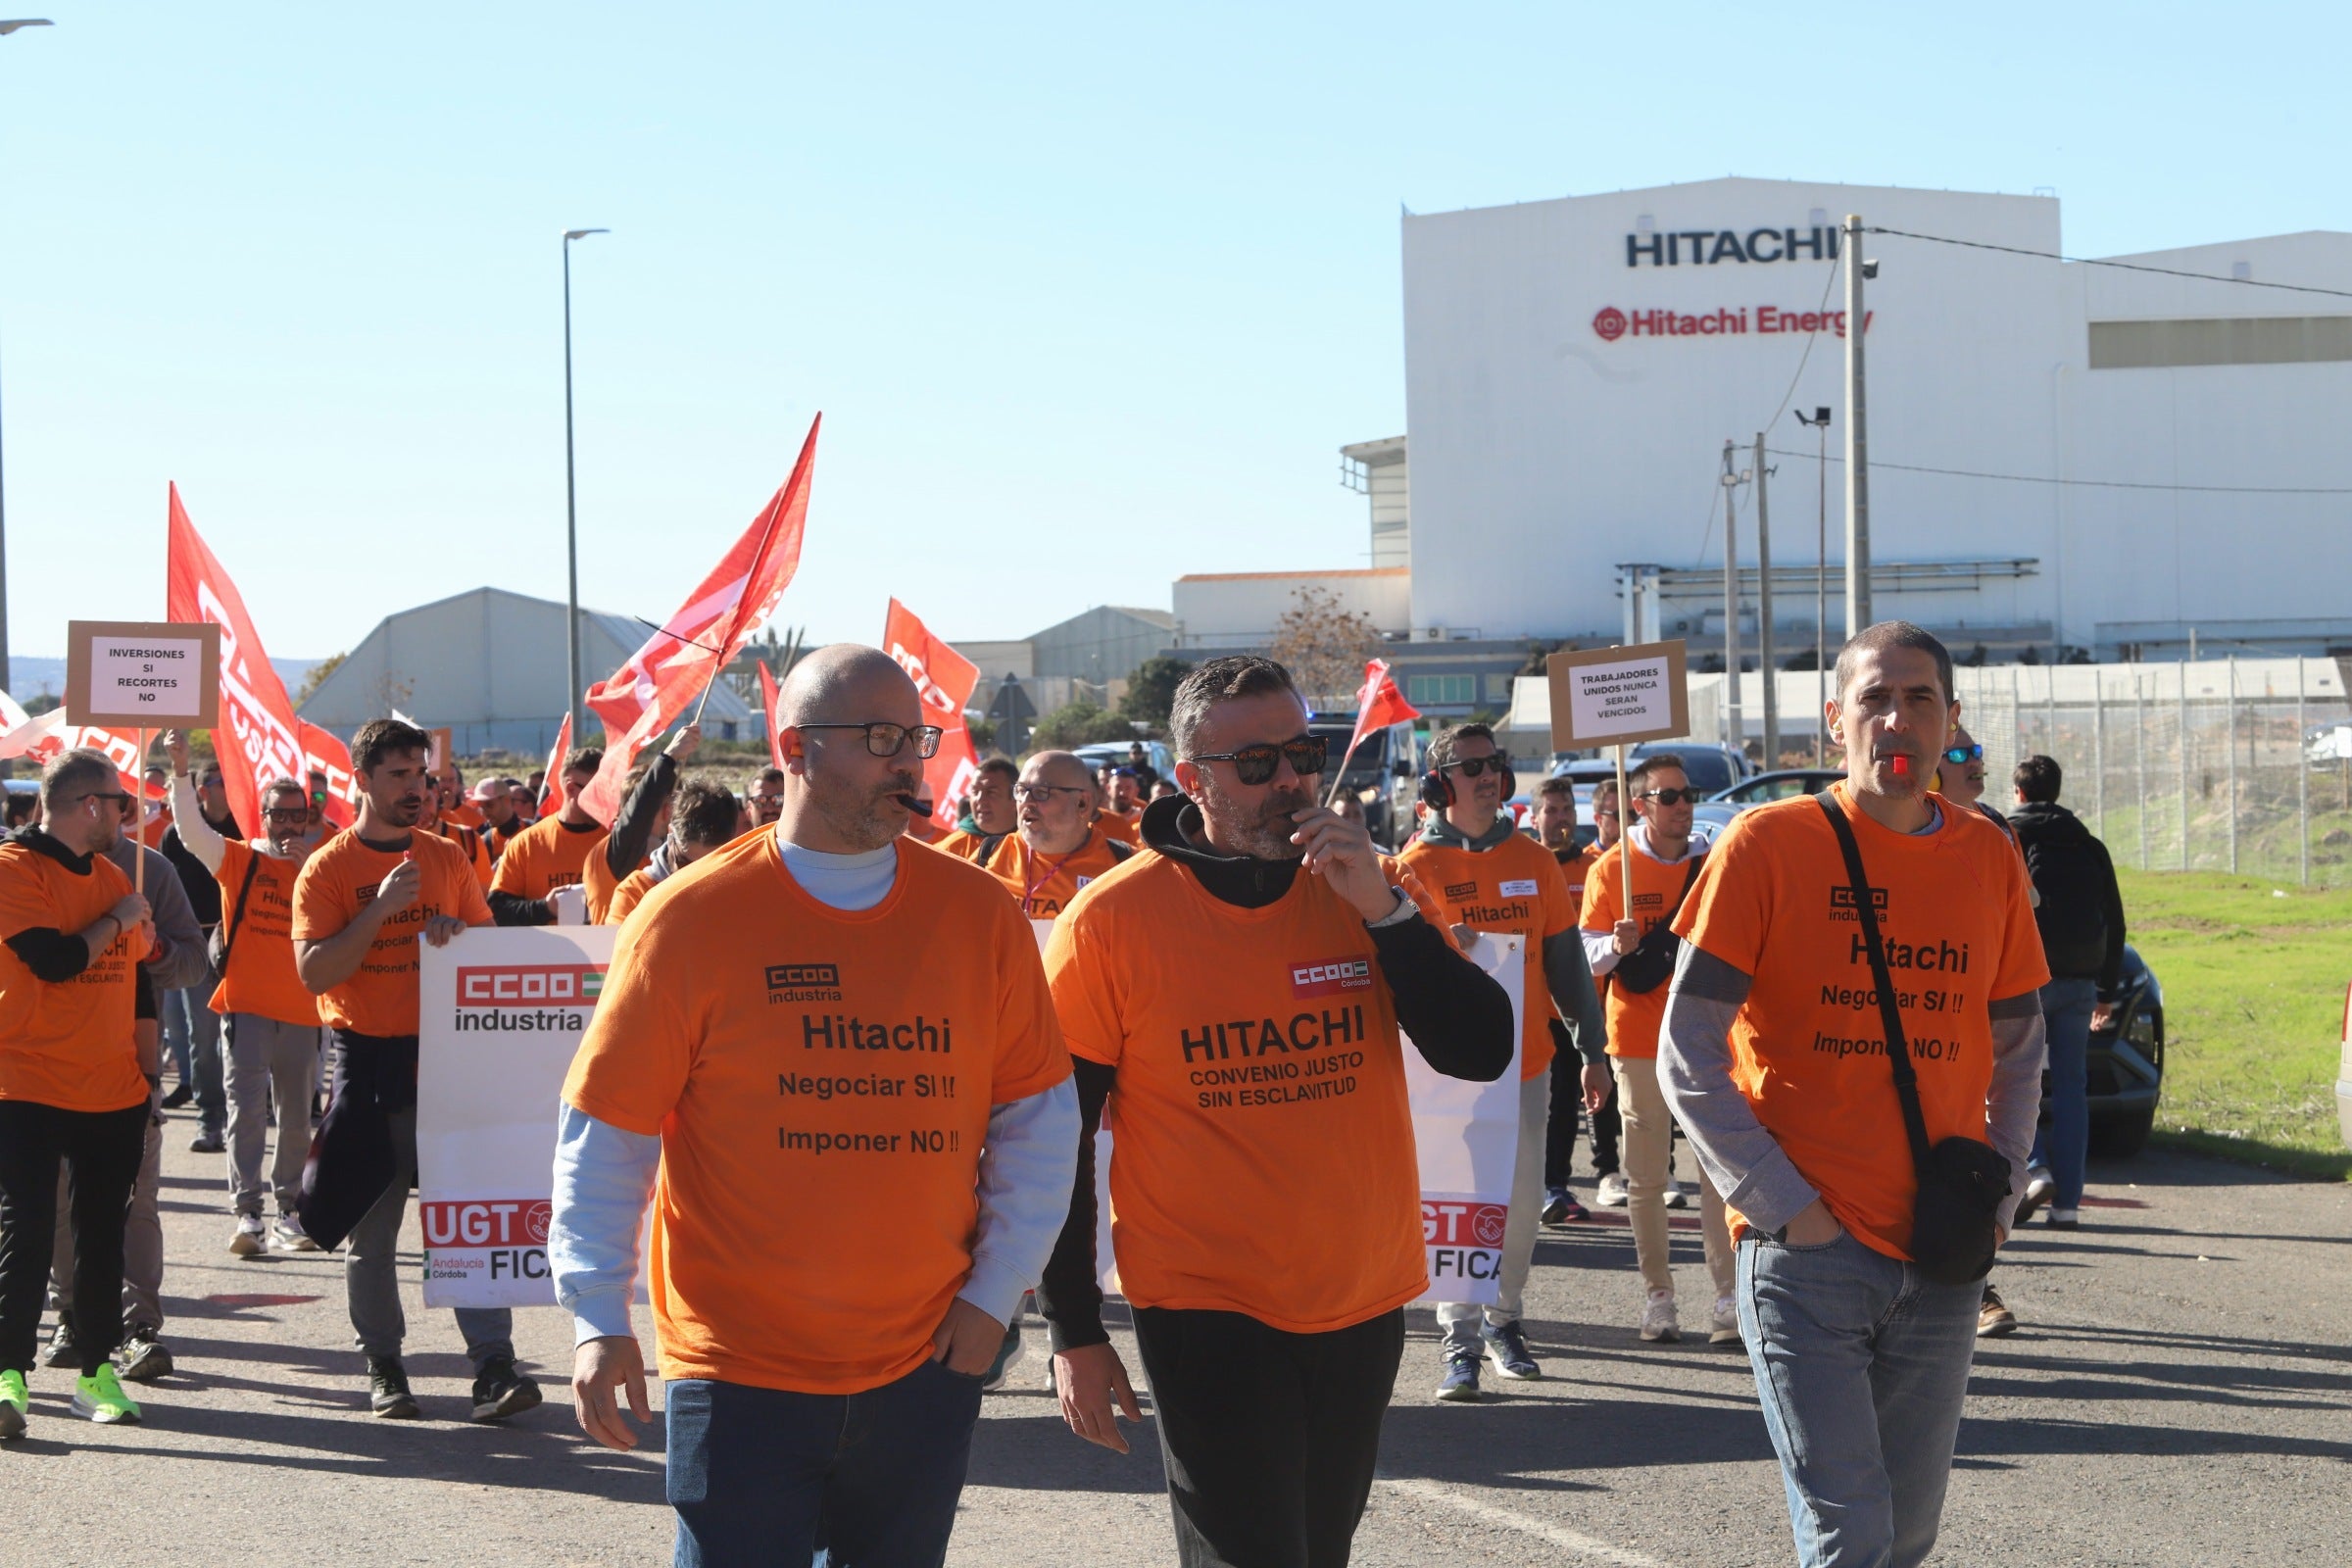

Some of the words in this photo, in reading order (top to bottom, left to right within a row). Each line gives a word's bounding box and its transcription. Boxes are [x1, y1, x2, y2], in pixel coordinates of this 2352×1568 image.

[1626, 226, 1838, 268] HITACHI
[1631, 307, 1746, 337] Hitachi
[109, 648, 185, 660] INVERSIONES
[142, 663, 154, 673] SI
[1581, 668, 1659, 684] TRABAJADORES
[118, 677, 177, 688] RECORTES
[1584, 686, 1622, 696] UNIDOS
[1623, 681, 1657, 692] NUNCA
[138, 693, 156, 703] NO
[1605, 695, 1638, 706] SERAN
[1597, 706, 1646, 718] VENCIDOS
[1461, 902, 1530, 924] Hitachi
[1849, 933, 1969, 974] Htachi
[769, 967, 835, 985] CCOO
[1294, 961, 1354, 985] CCOO
[465, 972, 575, 1000] CCOO
[768, 986, 842, 1004] industria
[1821, 984, 1918, 1011] Negoiar
[1923, 990, 1947, 1012] SI
[455, 1008, 583, 1031] industria
[802, 1014, 952, 1054] Hitachi
[1180, 1004, 1364, 1063] HITACHI
[1913, 1037, 1942, 1060] NO
[1190, 1062, 1299, 1087] CONVENIO
[1304, 1051, 1364, 1077] JUSTO
[778, 1072, 906, 1101] Negociar
[914, 1074, 937, 1098] SI
[1198, 1090, 1233, 1108] SIN
[1239, 1076, 1356, 1107] ESCLAVITUD
[778, 1127, 902, 1155] Imponer
[910, 1130, 945, 1153] NO
[425, 1203, 518, 1245] UGT
[1421, 1203, 1467, 1243] GT
[432, 1269, 467, 1279] Córdoba
[490, 1249, 553, 1280] FIC
